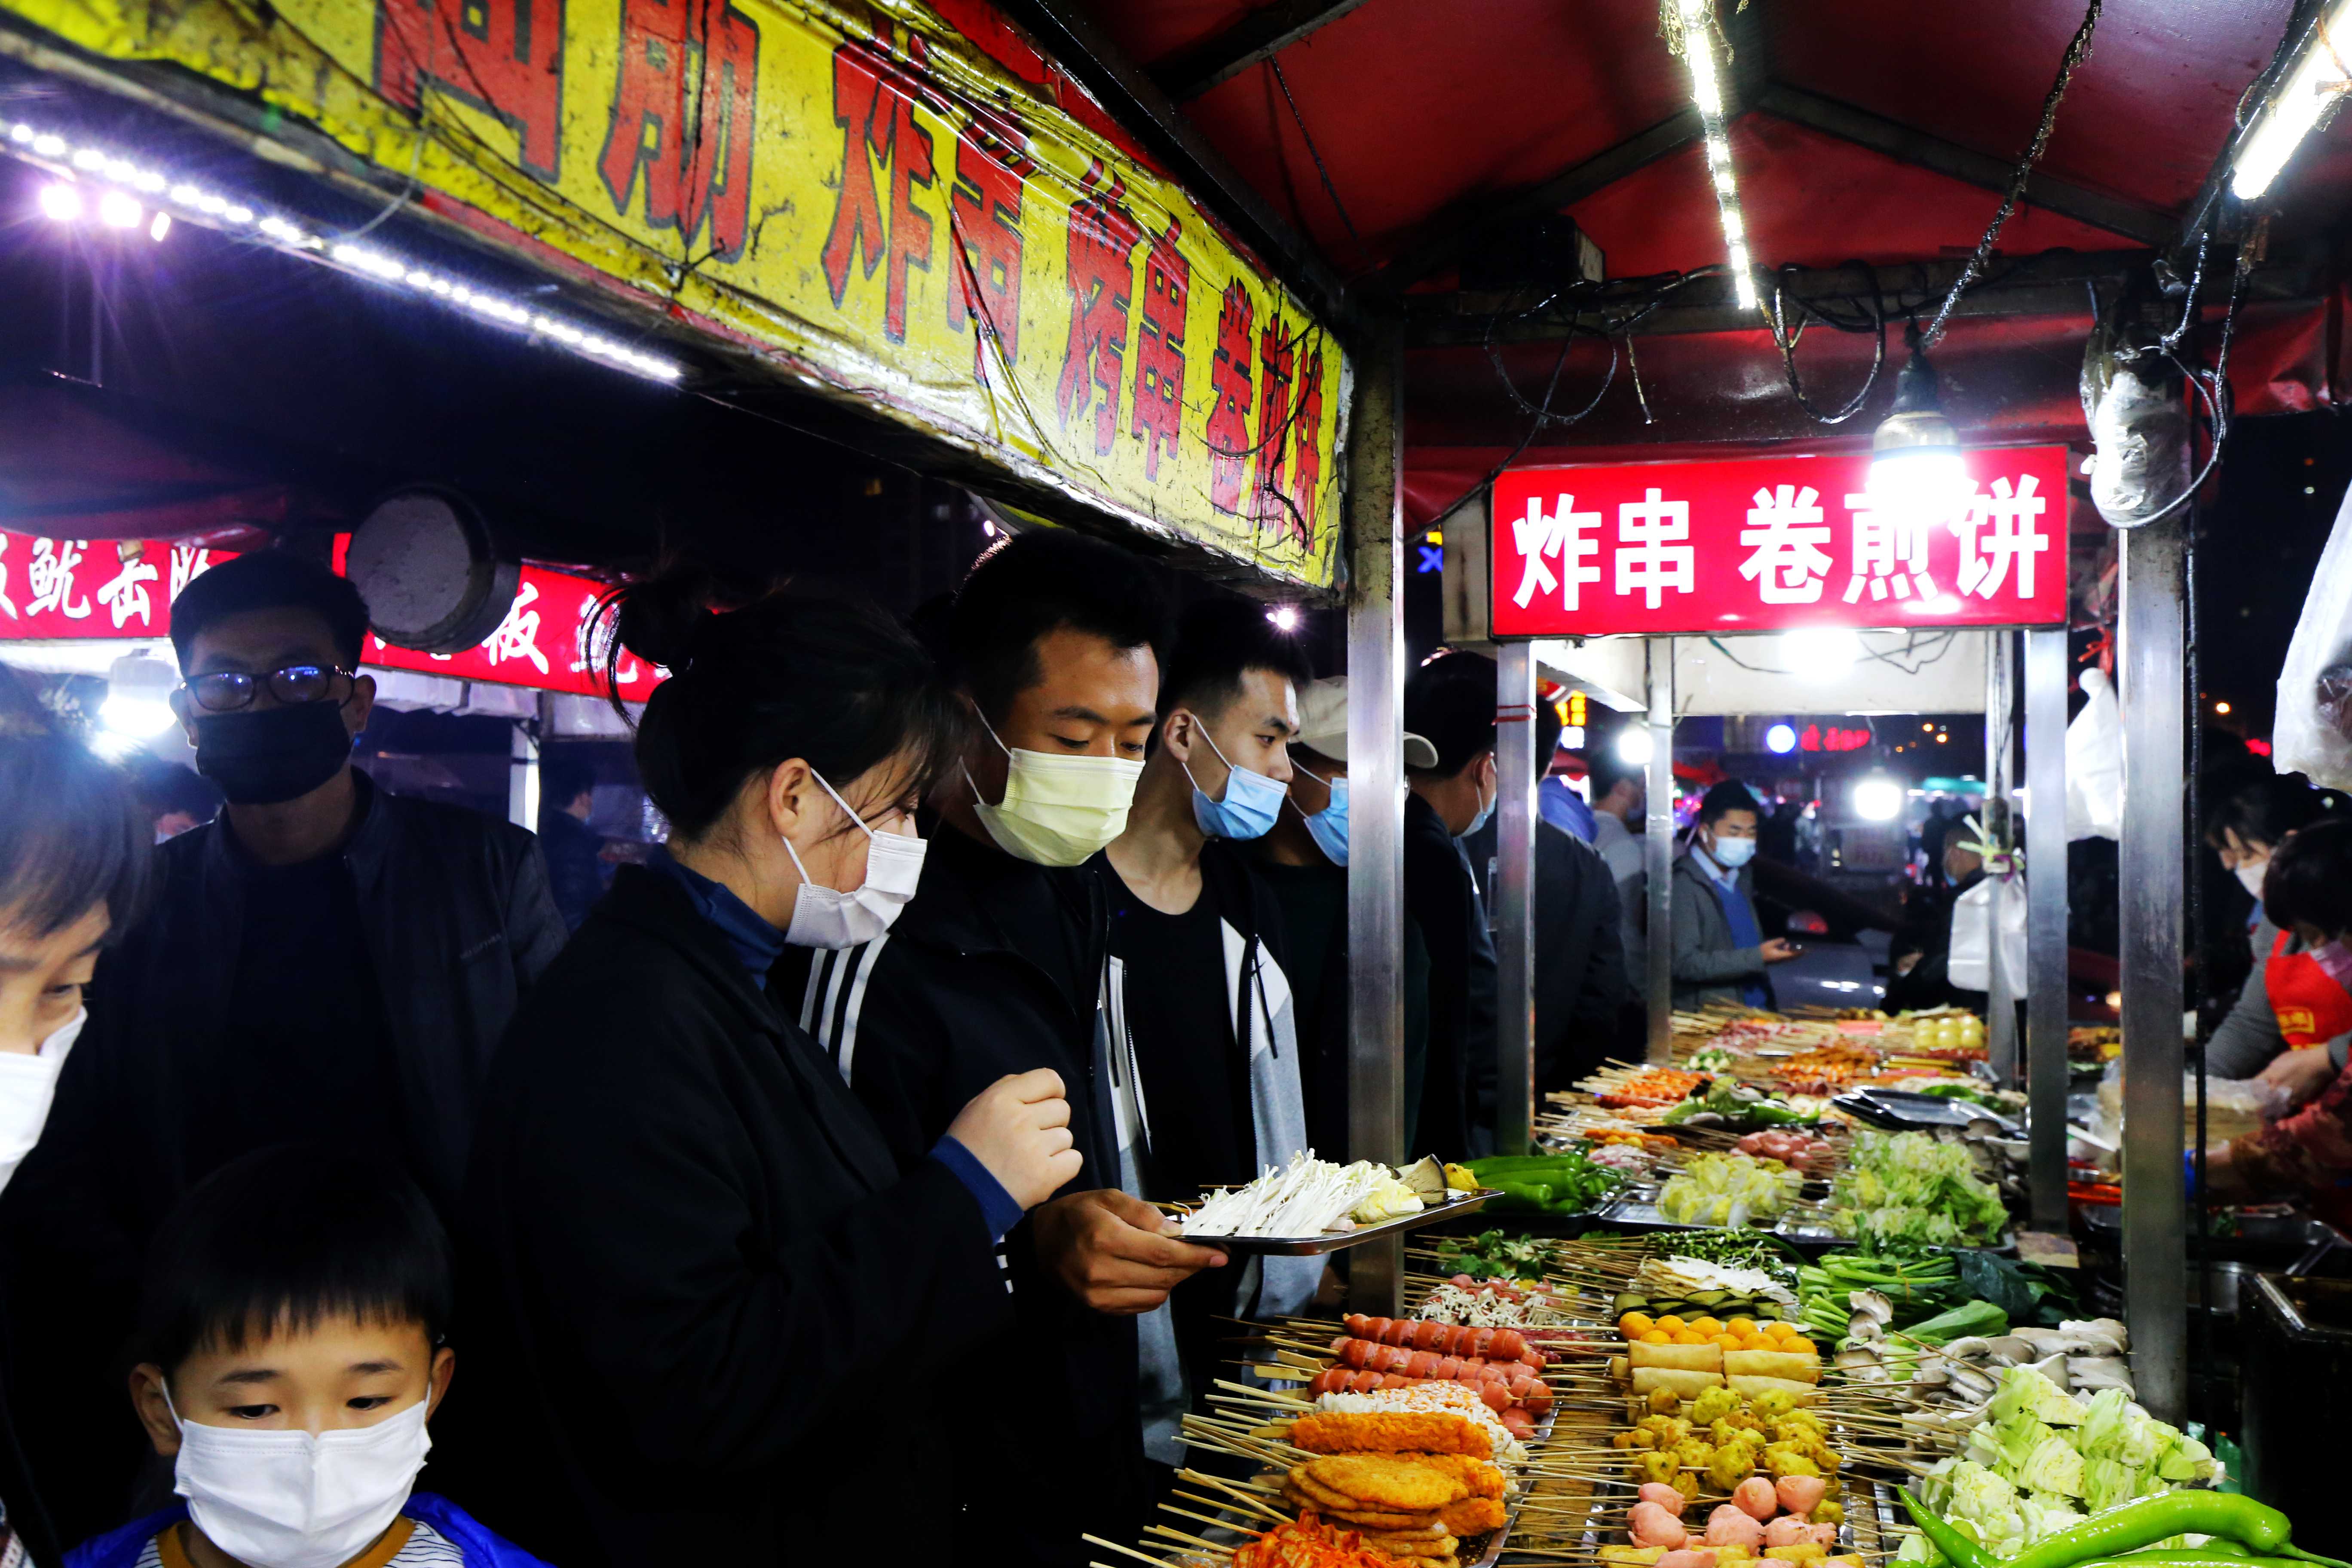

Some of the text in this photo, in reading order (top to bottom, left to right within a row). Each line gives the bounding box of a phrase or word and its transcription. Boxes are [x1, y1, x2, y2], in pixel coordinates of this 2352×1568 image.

[1056, 157, 1189, 482] 烤串
[1512, 474, 2049, 611] 炸串 卷煎饼
